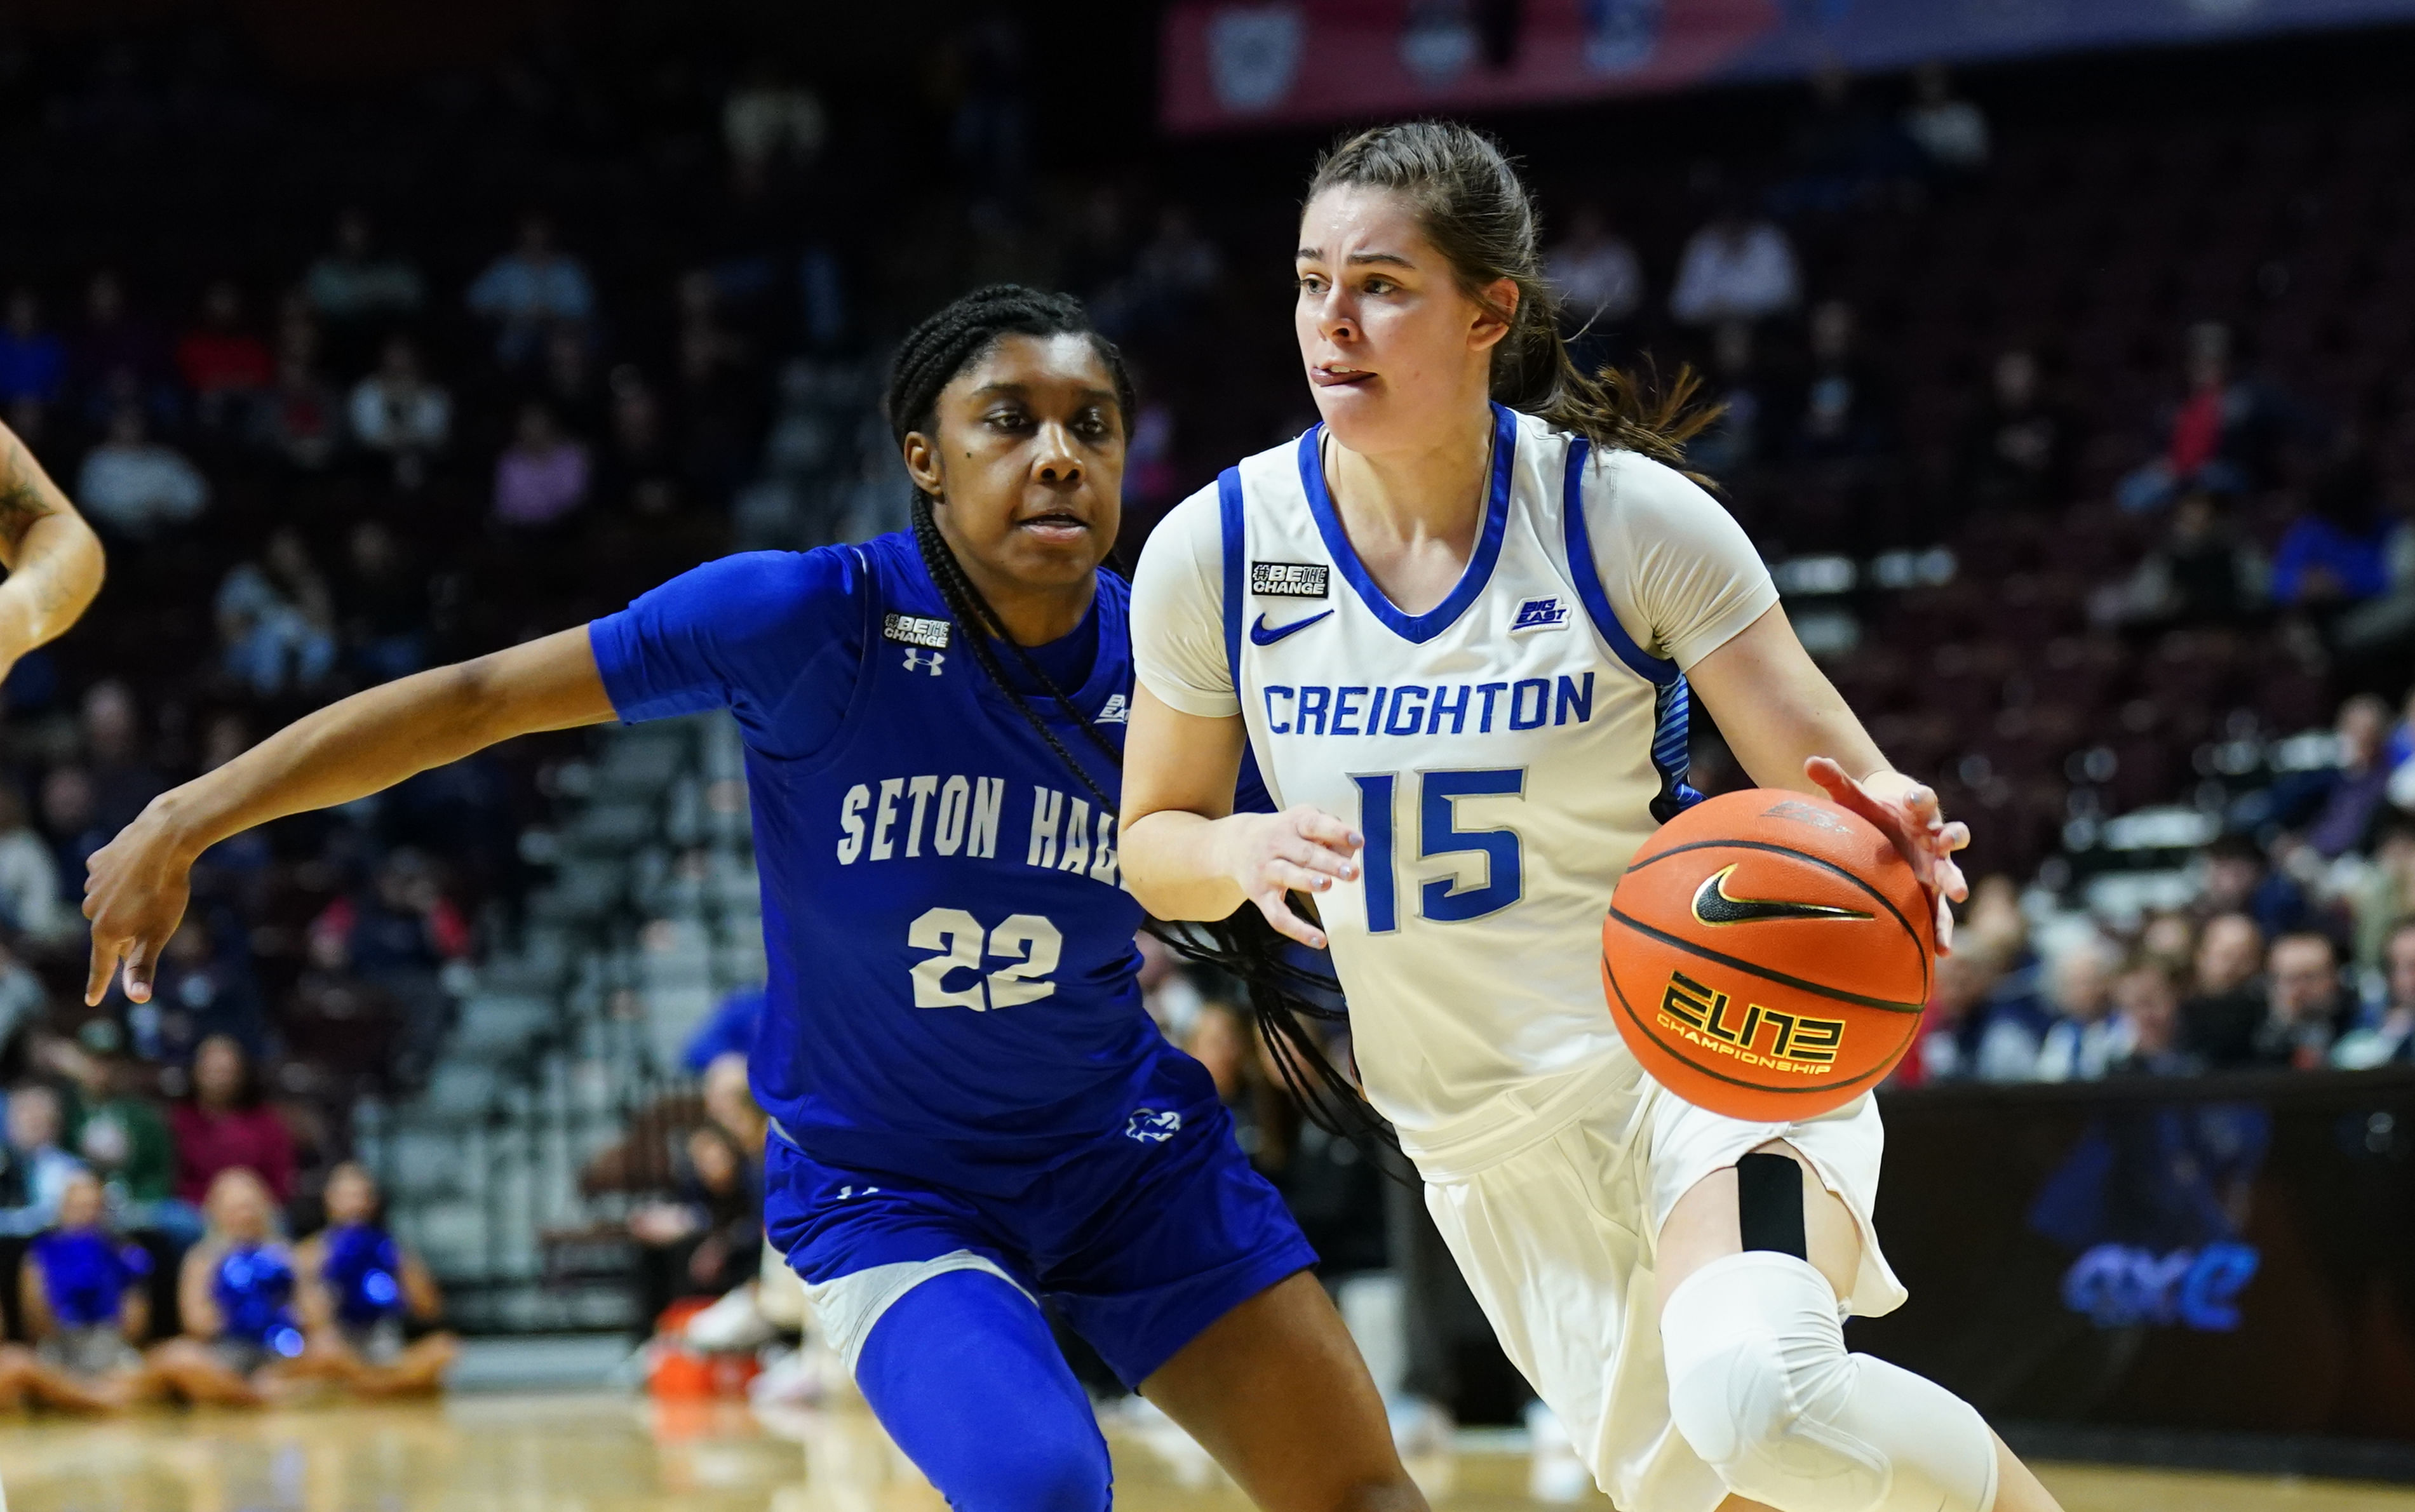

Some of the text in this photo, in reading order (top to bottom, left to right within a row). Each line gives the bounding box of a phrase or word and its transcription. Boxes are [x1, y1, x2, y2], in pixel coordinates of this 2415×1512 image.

[1253, 580, 1326, 595] CHANGE
[1516, 609, 1567, 624] EAST
[1520, 599, 1557, 613] BIG
[884, 627, 948, 648] CHANGE
[1263, 672, 1594, 735] CREIGHTON
[836, 774, 1131, 893] SETON HAL
[1344, 763, 1530, 936] 15
[907, 907, 1063, 1013] 22
[1657, 1014, 1831, 1074] CHAMPIONSHIP
[1660, 969, 1846, 1064] ELITE
